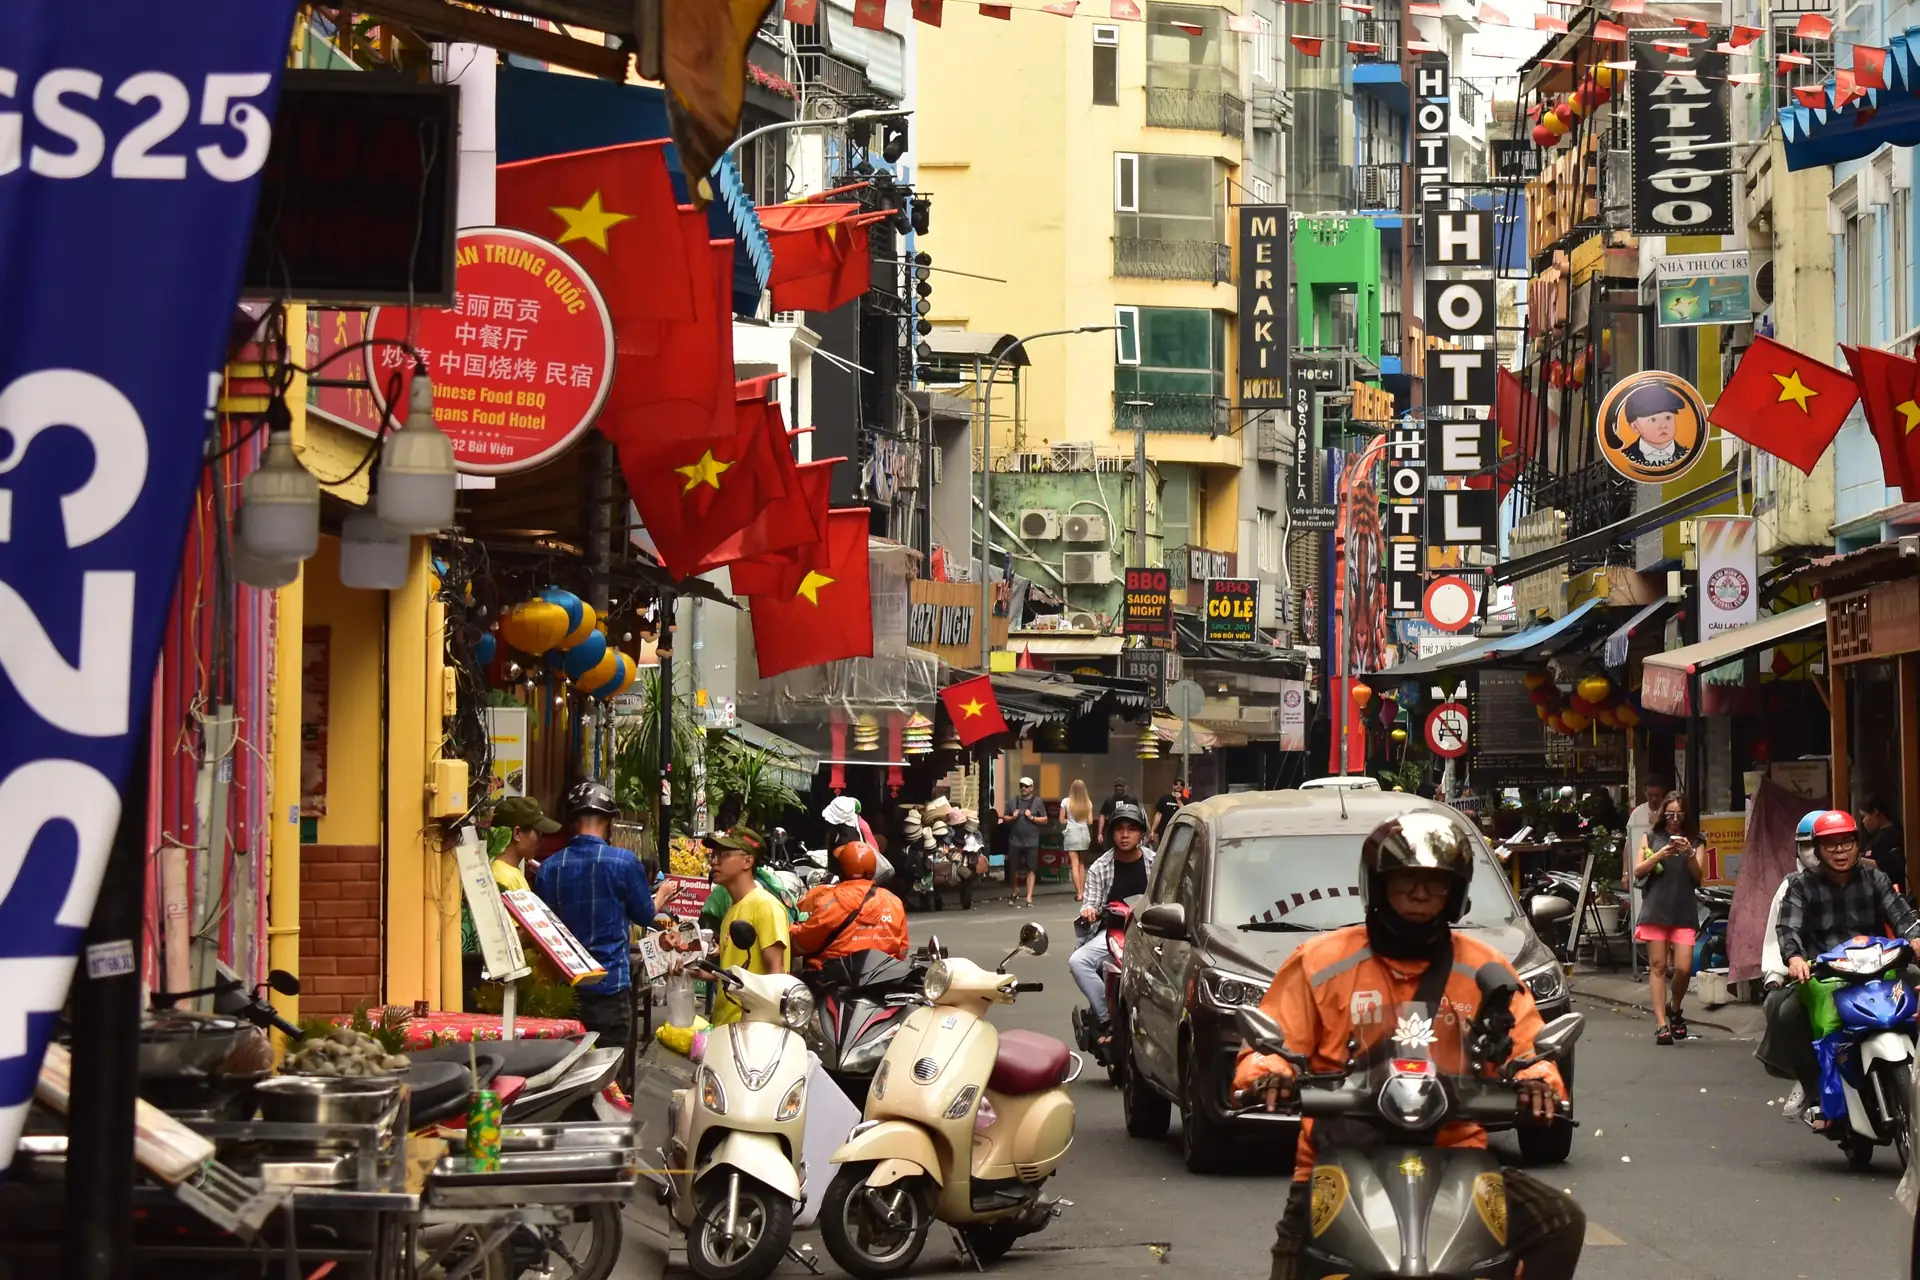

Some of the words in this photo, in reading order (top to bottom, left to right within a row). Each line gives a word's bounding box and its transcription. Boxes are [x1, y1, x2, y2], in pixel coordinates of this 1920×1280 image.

[1649, 38, 1712, 225] TATTOO
[1660, 259, 1684, 273] NHÀ
[1687, 257, 1728, 271] THUỐC
[1732, 258, 1748, 269] 183
[484, 244, 546, 277] TRUNG
[545, 268, 587, 315] QUỐC
[1251, 216, 1277, 369] MERAKI
[455, 322, 528, 351] 中餐厅
[440, 350, 537, 383] 中国烧烤
[545, 361, 593, 388] 民宿
[1298, 368, 1333, 380] Hotel
[1438, 214, 1483, 541] HOTEL
[432, 383, 476, 400] hinese
[480, 387, 512, 404] Food
[517, 391, 546, 408] BBQ
[1243, 377, 1283, 399] HOTEL
[434, 409, 468, 424] gans
[472, 408, 505, 426] Food
[509, 411, 546, 430] Hotel
[468, 438, 487, 453] Bùi
[490, 441, 513, 458] Viện
[1393, 431, 1420, 609] HOTEL
[1127, 572, 1168, 591] BBQ
[1215, 581, 1250, 595] BBQ
[1127, 594, 1166, 605] SAIGON
[1208, 596, 1231, 617] CÔ
[1233, 597, 1254, 622] LỆ
[1130, 606, 1162, 617] NIGHT
[940, 605, 975, 645] NIGHT
[1130, 663, 1158, 678] BBQ
